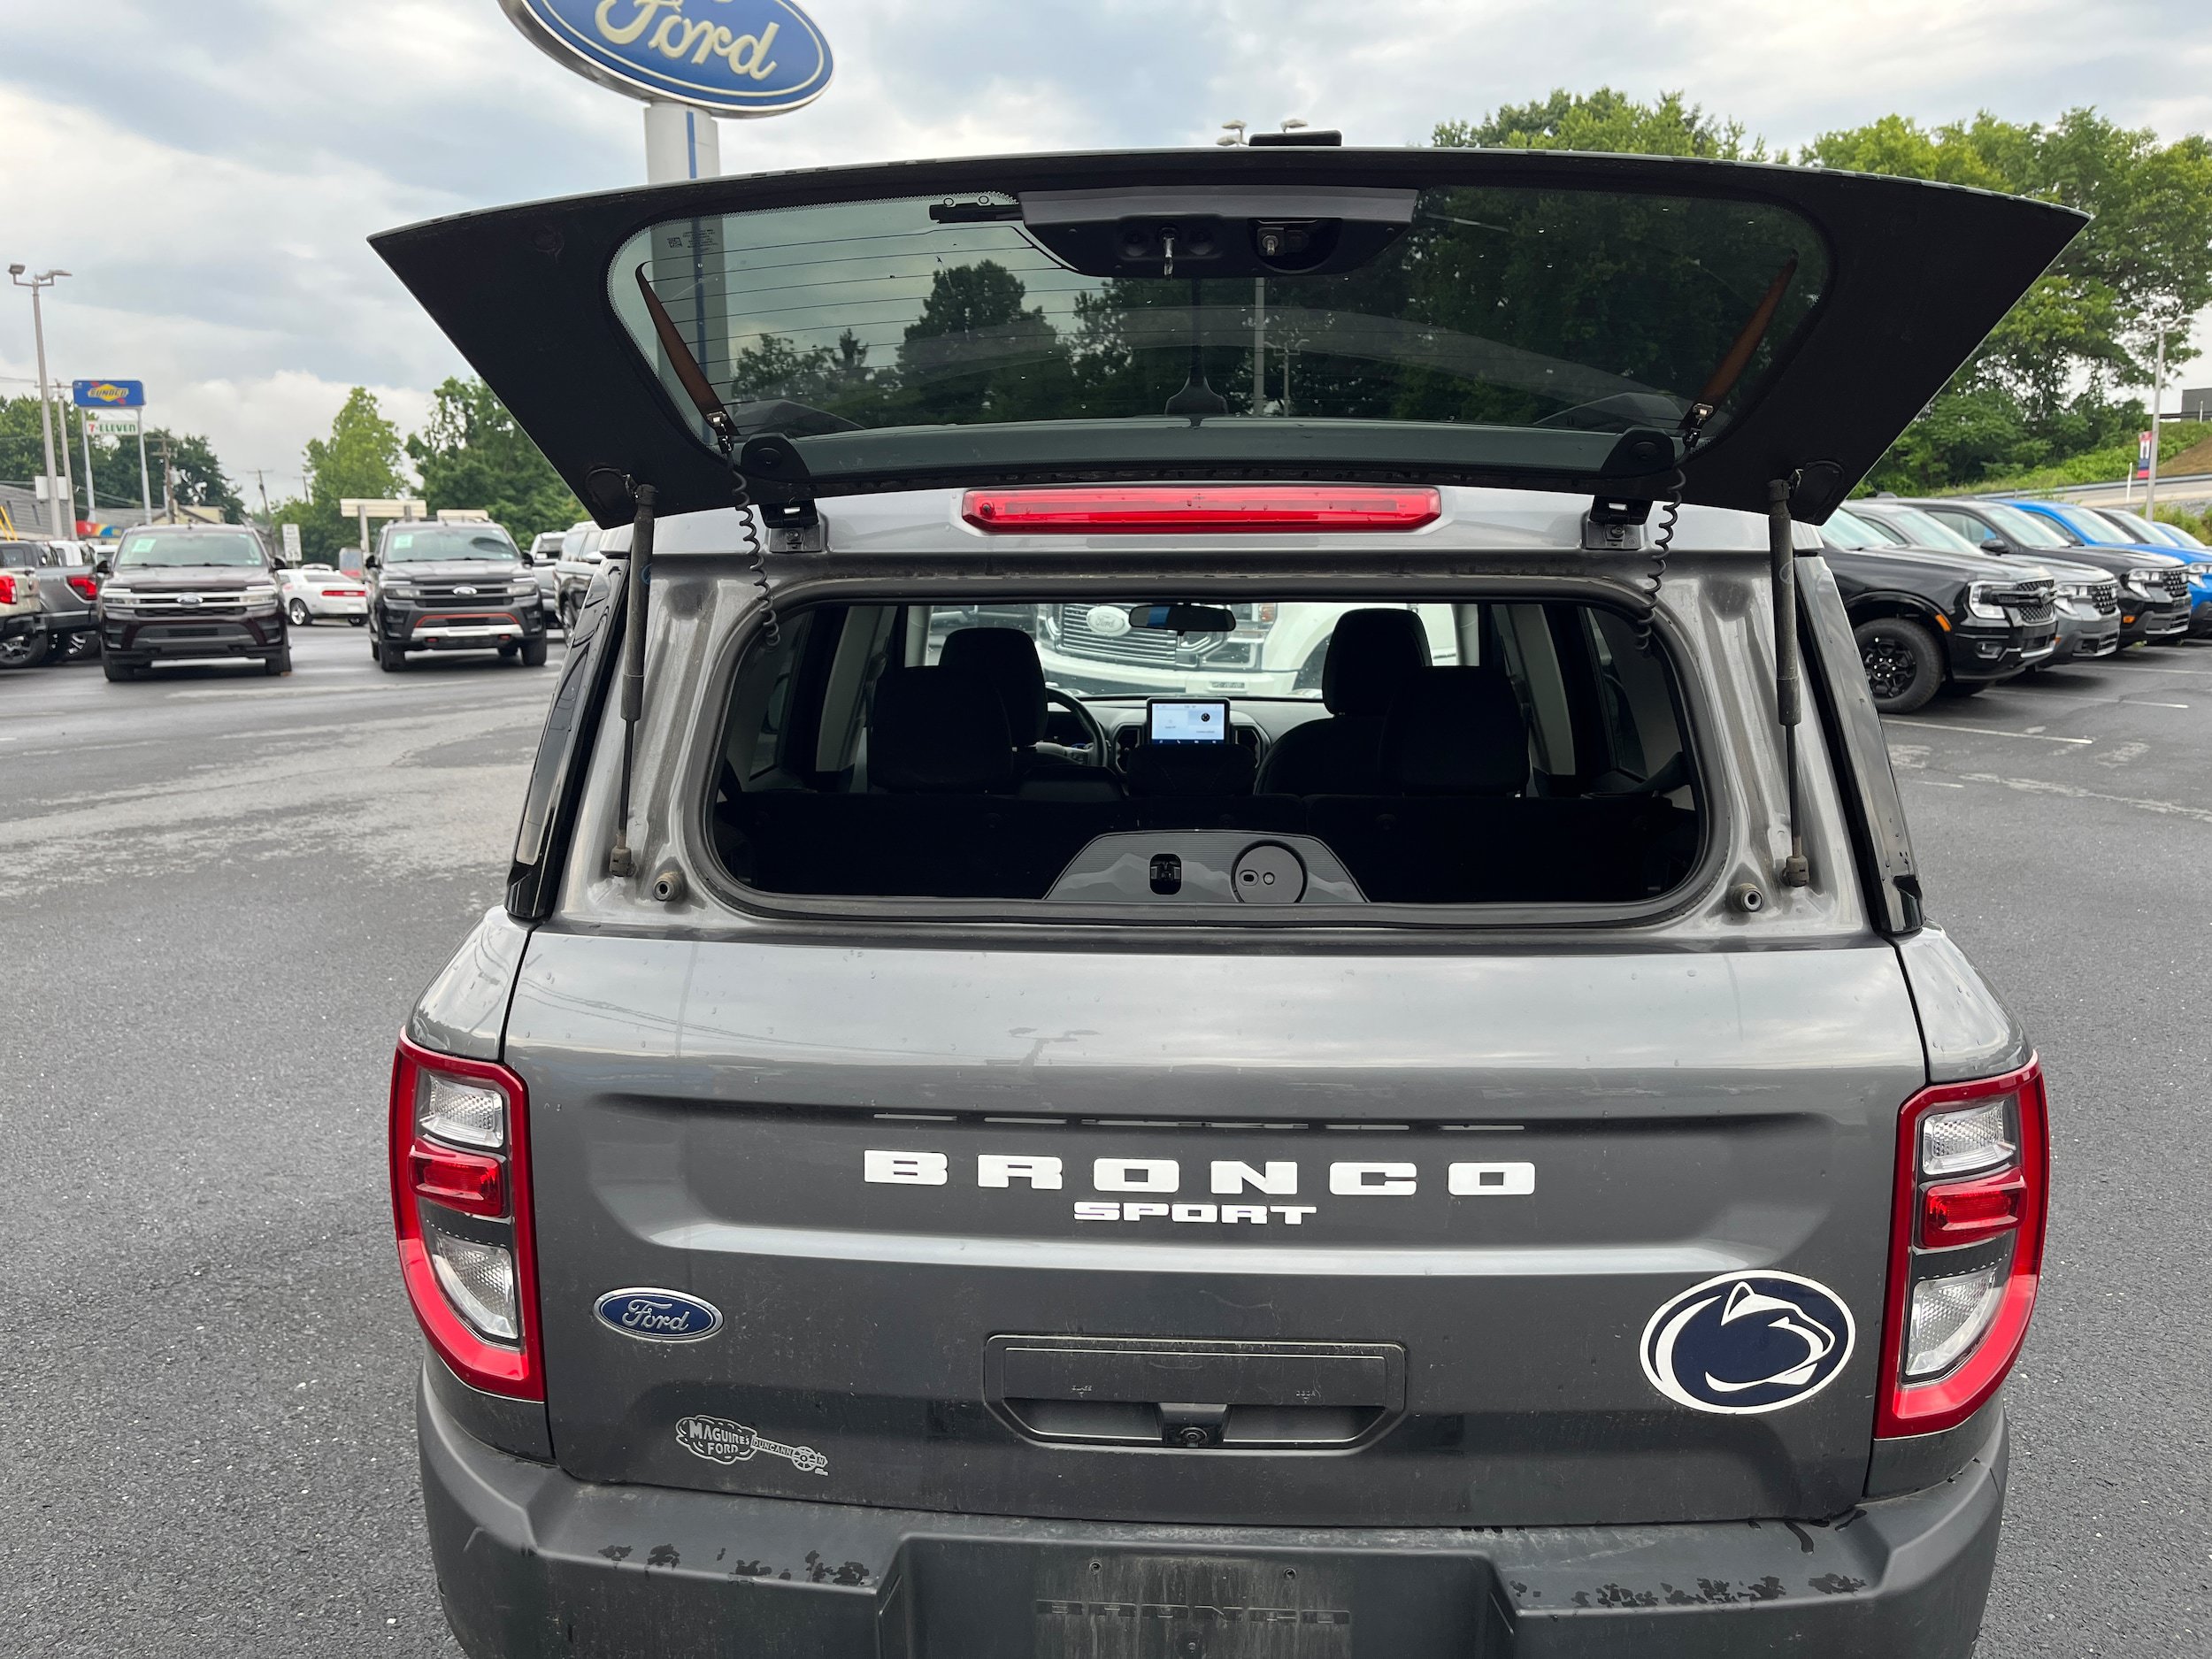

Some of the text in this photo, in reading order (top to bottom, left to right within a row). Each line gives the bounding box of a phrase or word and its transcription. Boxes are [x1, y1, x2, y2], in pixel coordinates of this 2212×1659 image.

[594, 0, 780, 81] Ford
[88, 388, 129, 397] SUNOCO
[864, 1149, 1536, 1195] BRONCO
[1073, 1200, 1317, 1225] SPORT
[621, 1299, 690, 1332] Ford
[688, 1420, 750, 1445] MAGUIRE'S
[707, 1442, 740, 1455] FORD
